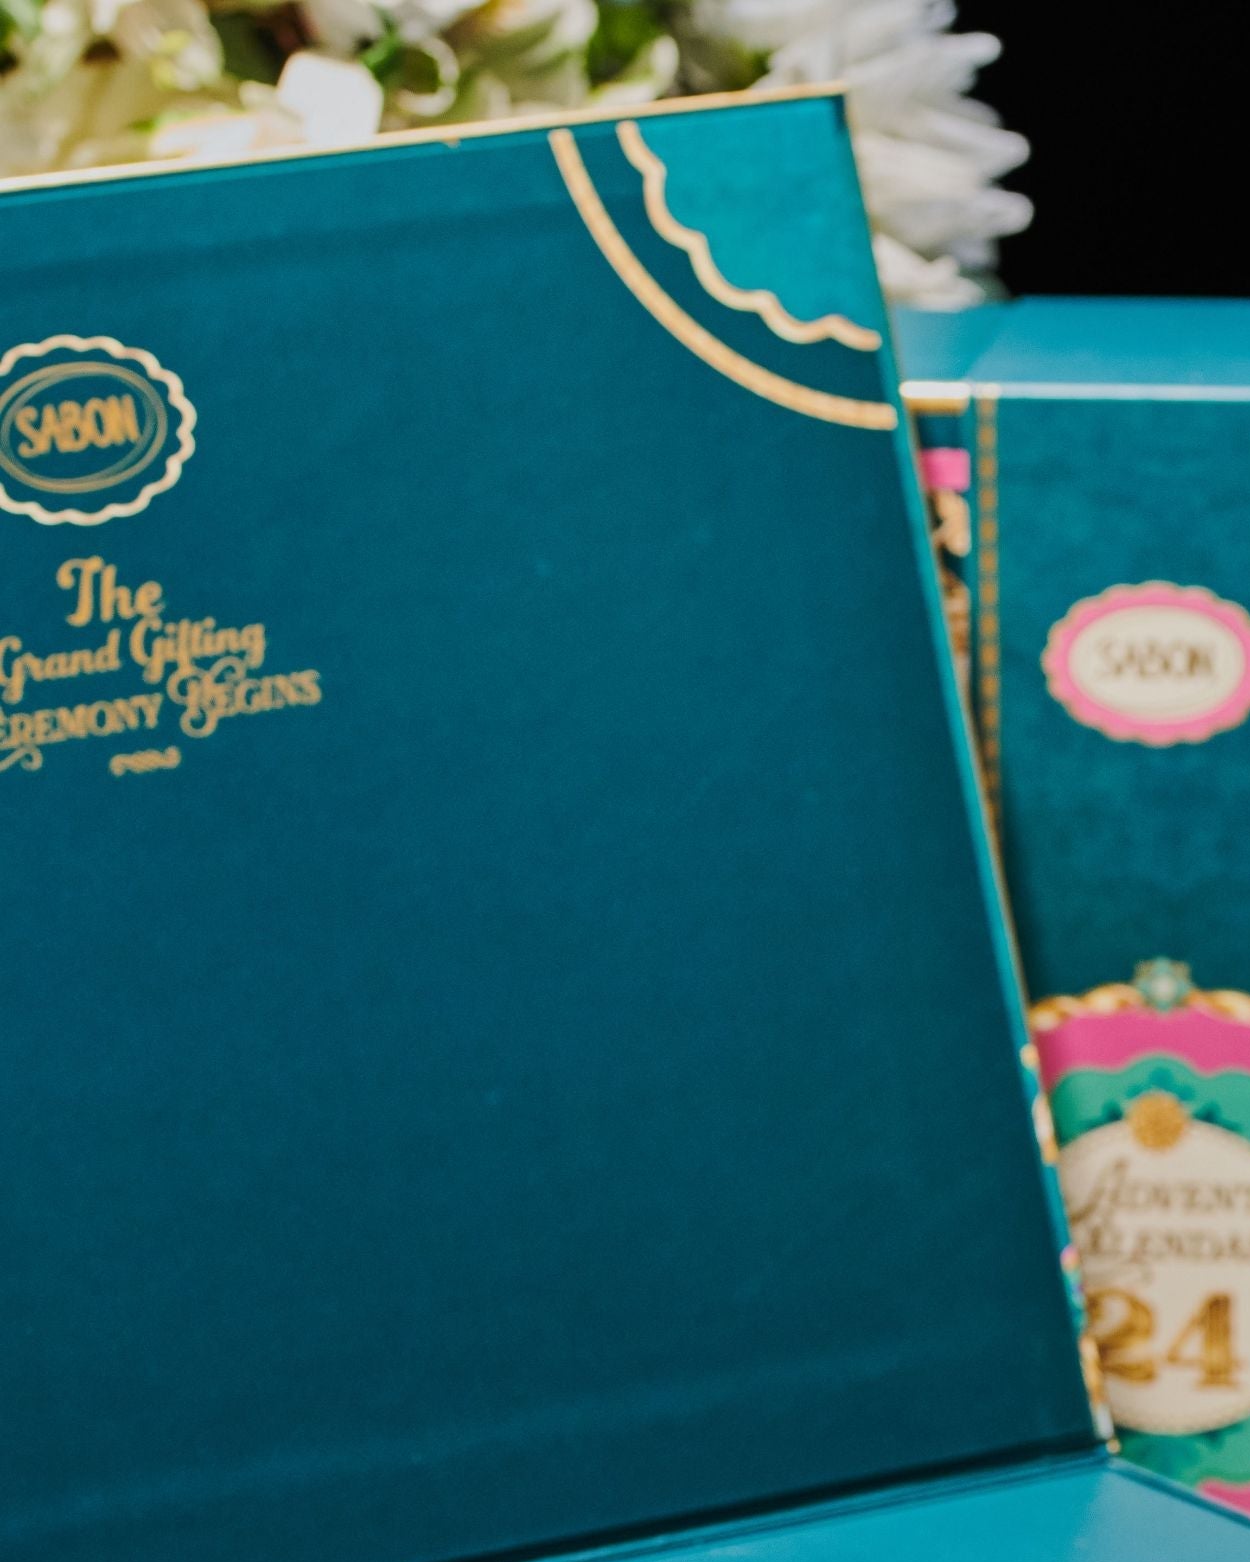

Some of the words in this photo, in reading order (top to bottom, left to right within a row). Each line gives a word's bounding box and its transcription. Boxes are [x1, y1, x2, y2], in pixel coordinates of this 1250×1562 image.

[14, 394, 140, 458] SABON
[56, 555, 166, 627] The
[0, 628, 122, 706] Grand
[129, 616, 266, 684] Gifting
[167, 655, 322, 738] BEGINS
[1086, 1288, 1241, 1391] 24
